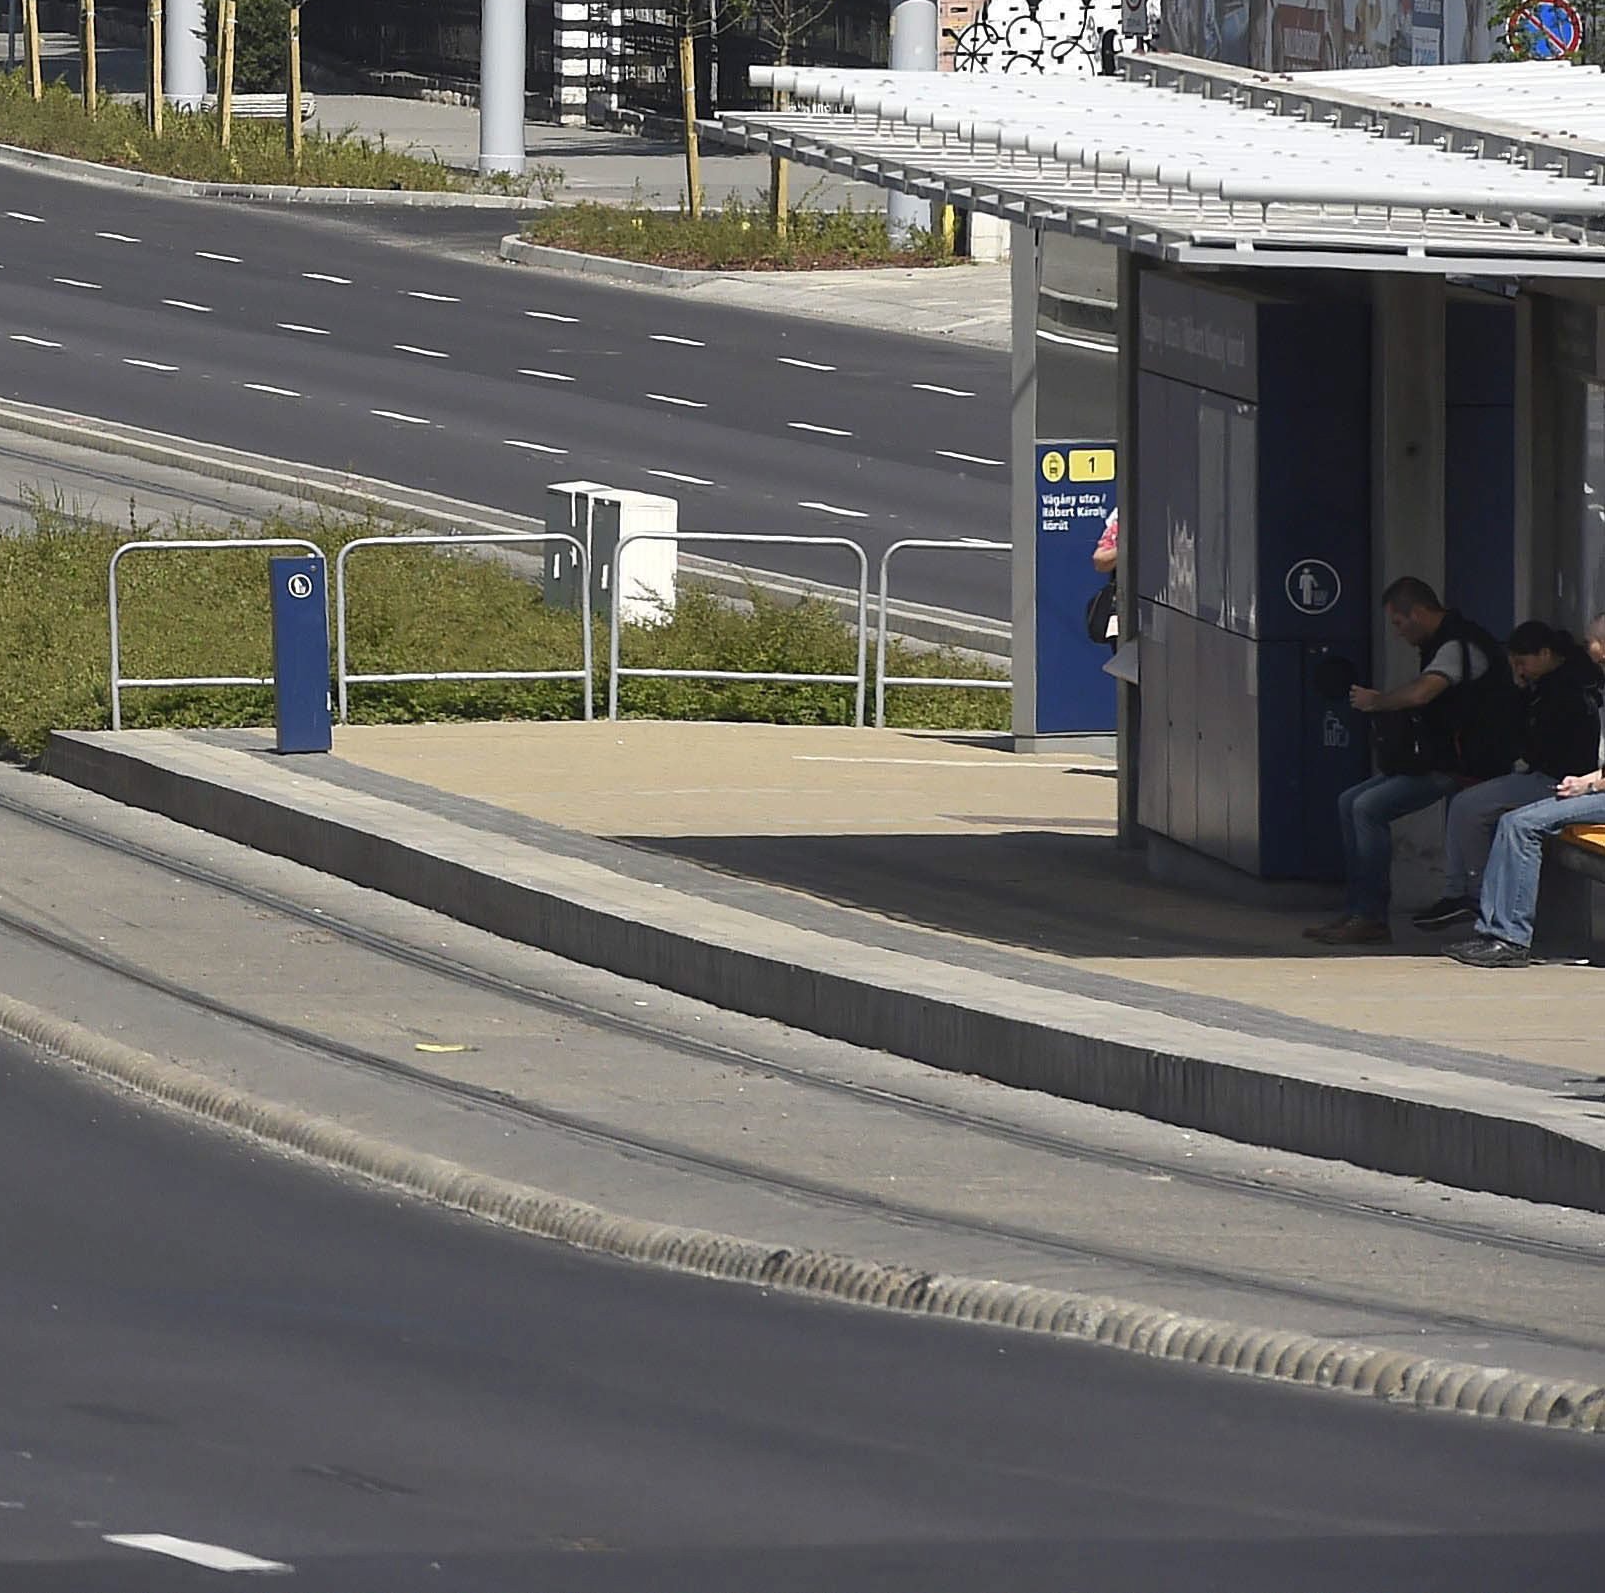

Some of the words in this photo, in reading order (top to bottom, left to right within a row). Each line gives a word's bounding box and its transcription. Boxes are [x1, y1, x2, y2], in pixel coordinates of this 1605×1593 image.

[1088, 456, 1095, 474] 1
[1041, 493, 1077, 507] Vágány
[1078, 493, 1100, 504] utca
[1042, 506, 1074, 518] Róbert
